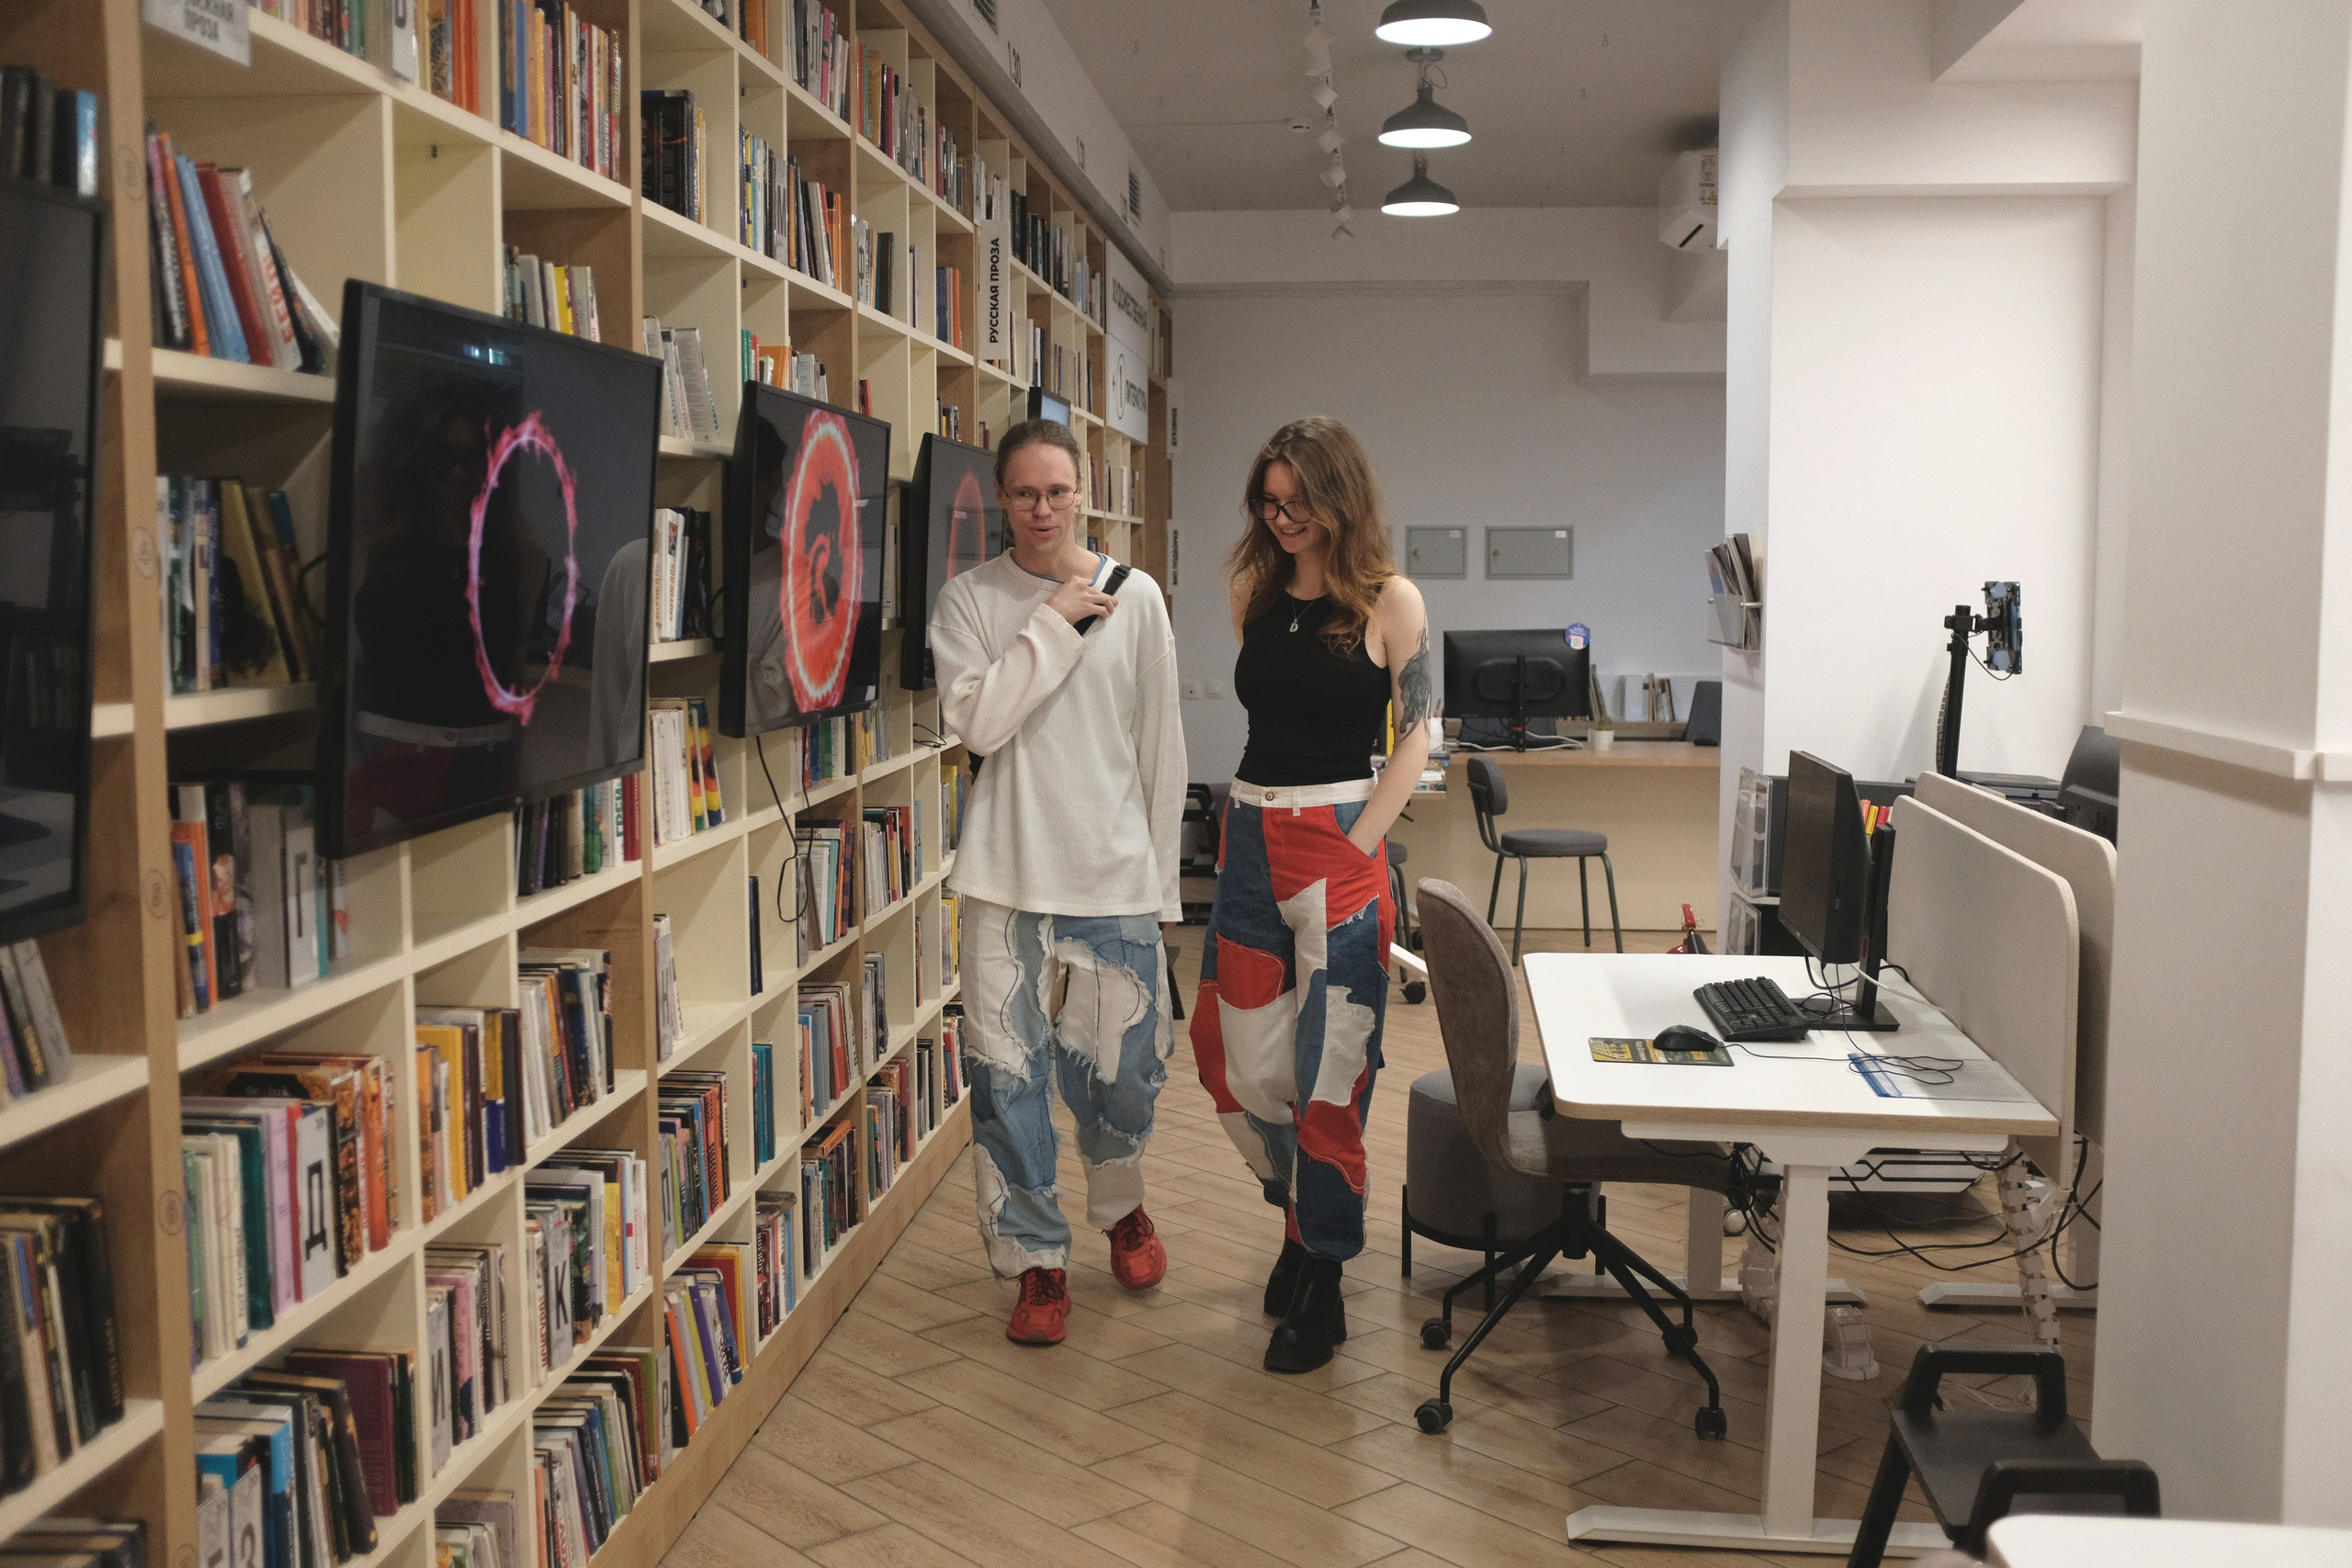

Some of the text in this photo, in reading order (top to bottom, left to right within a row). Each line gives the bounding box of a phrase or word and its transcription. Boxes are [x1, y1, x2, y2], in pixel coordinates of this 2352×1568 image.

[989, 237, 1000, 344] РУССКАЯ ПРОЗА
[295, 852, 307, 938] Г
[305, 1159, 328, 1261] Д
[662, 1168, 672, 1227] П
[554, 1259, 569, 1330] К
[431, 1347, 446, 1427] И
[662, 1380, 670, 1438] Р
